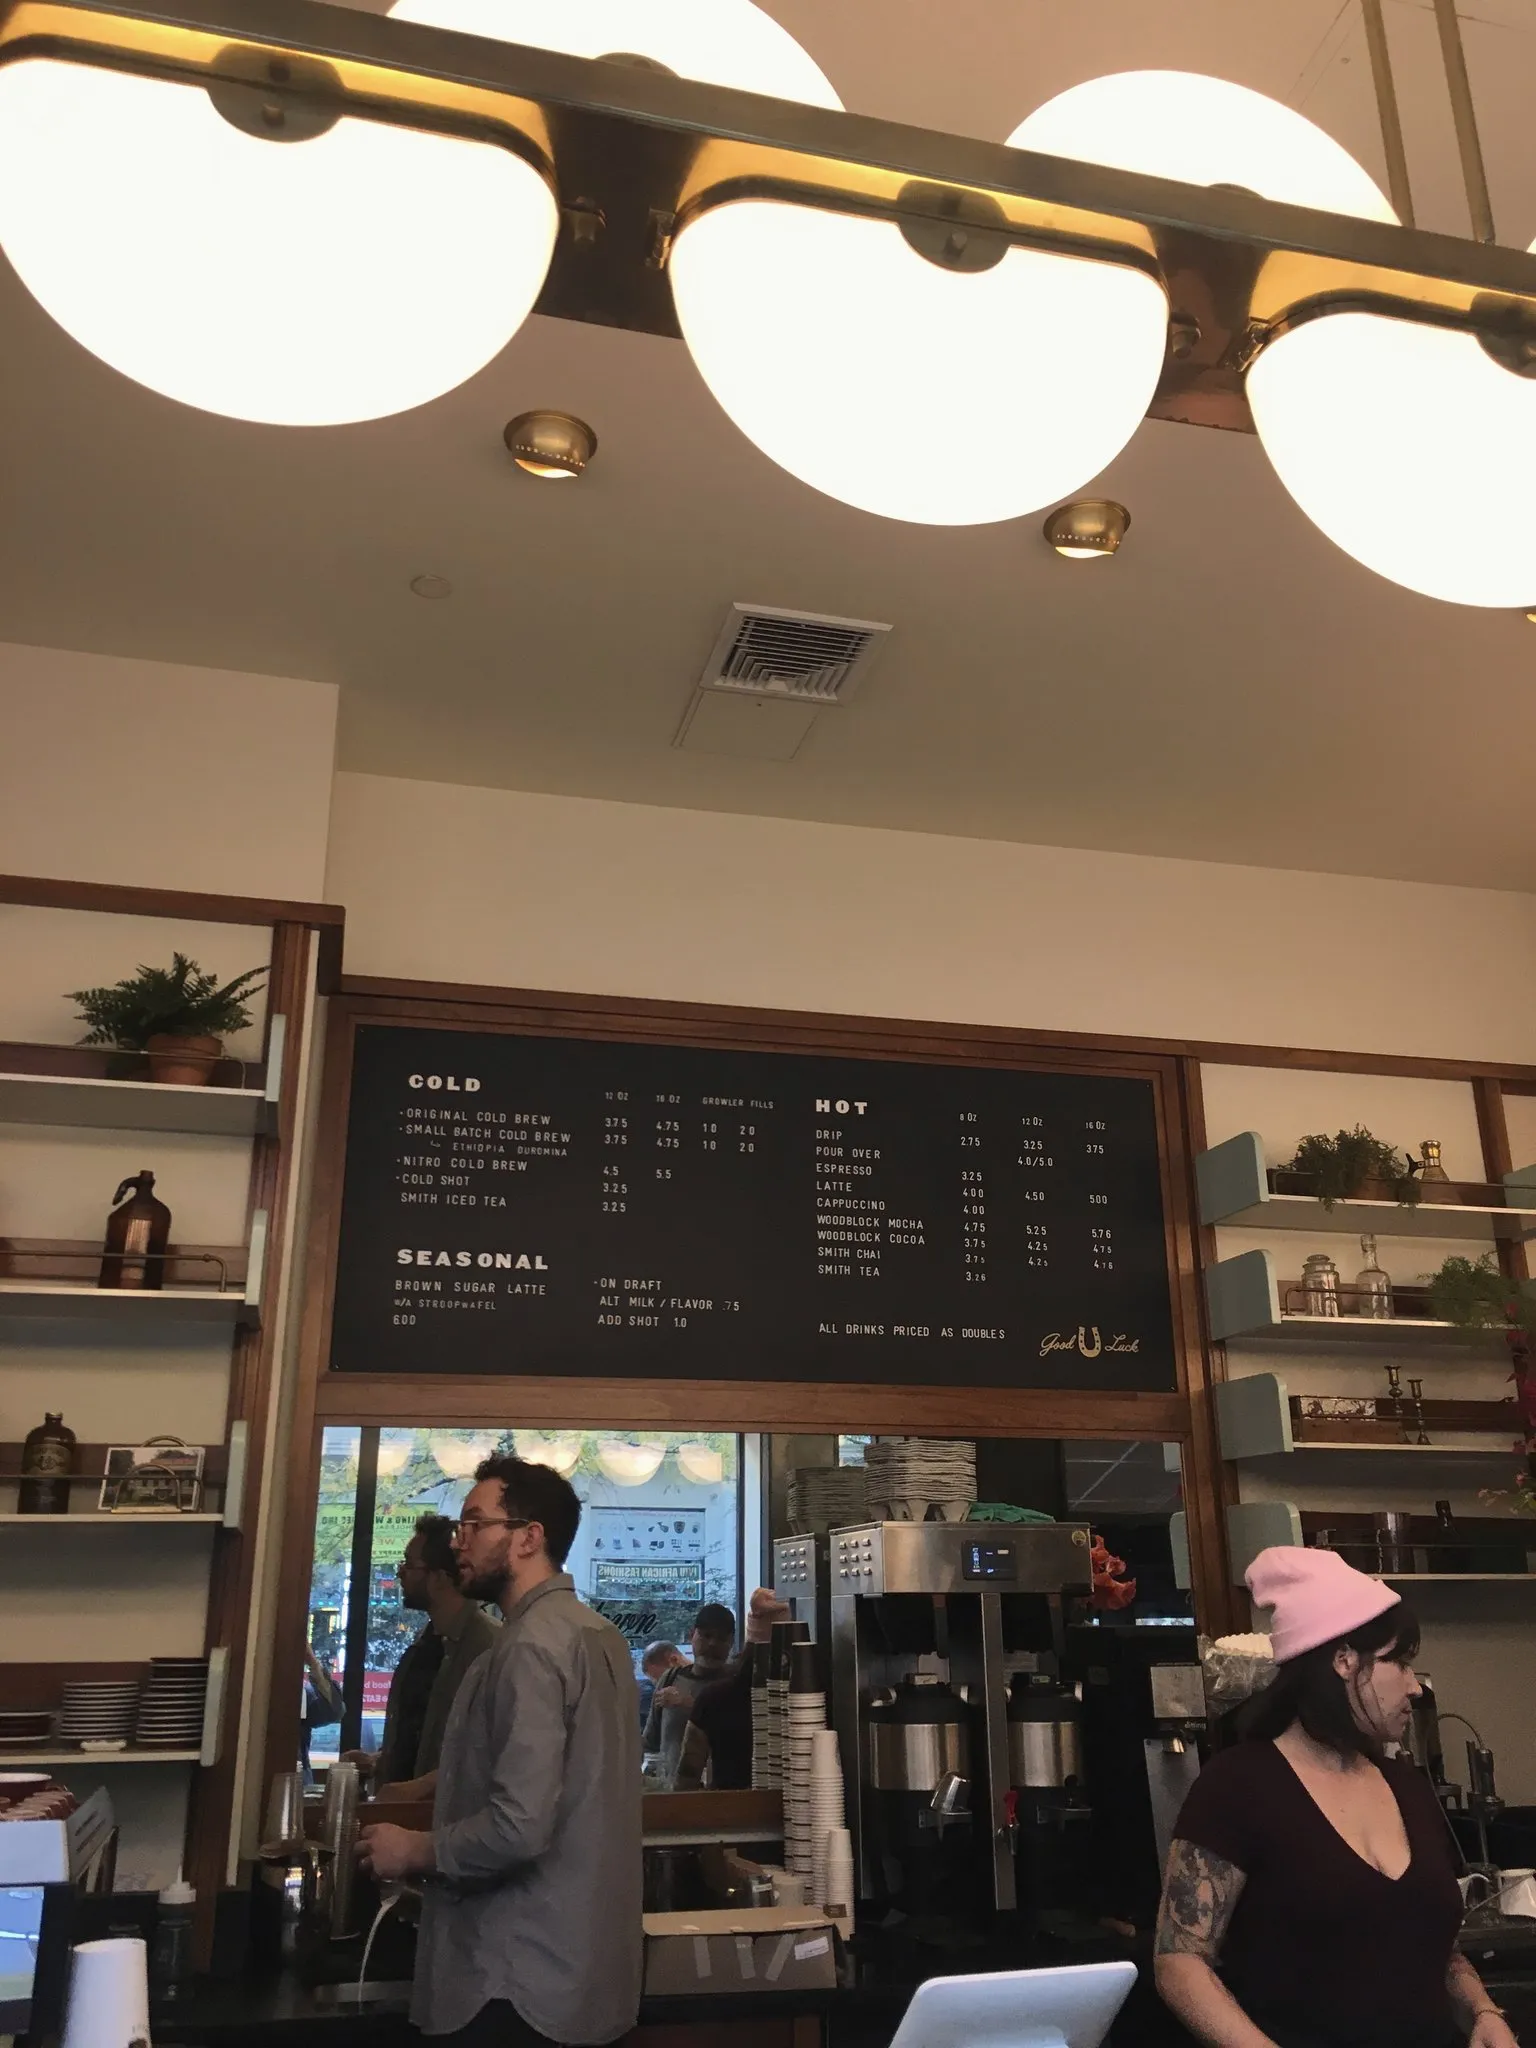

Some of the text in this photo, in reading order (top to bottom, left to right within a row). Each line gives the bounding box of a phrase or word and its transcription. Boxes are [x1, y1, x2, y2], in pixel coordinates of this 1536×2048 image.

[409, 1075, 480, 1091] COLD
[617, 1092, 628, 1100] OZ
[669, 1095, 680, 1103] OZ
[703, 1097, 773, 1109] GROWLER FILLS
[816, 1099, 867, 1114] HOT
[477, 1112, 506, 1123] COLD
[515, 1114, 550, 1124] BREW
[656, 1121, 679, 1131] 4.75
[704, 1124, 716, 1133] 10
[740, 1126, 754, 1135] 20
[454, 1127, 491, 1138] BATCH
[499, 1130, 527, 1140] COLD
[535, 1132, 570, 1142] BREW
[605, 1134, 627, 1144] 3.75
[816, 1130, 842, 1140] DRIP
[657, 1138, 679, 1148] 4.75
[703, 1141, 716, 1150] 10
[961, 1137, 980, 1146] 2.75
[453, 1143, 504, 1152] ETHIOPIA
[740, 1143, 754, 1152] 20
[816, 1146, 880, 1158] POUR OVER
[404, 1156, 527, 1170] NITRO COLD BREW
[604, 1166, 618, 1175] 4.5
[657, 1169, 671, 1179] 5.5
[817, 1163, 871, 1175] ESPRESSO
[403, 1174, 469, 1185] COLD SHOT
[962, 1172, 982, 1181] 3.25
[604, 1183, 627, 1193] 3.25
[817, 1181, 852, 1191] LATTE
[401, 1193, 506, 1206] SMITH ICED TEA
[1025, 1192, 1044, 1200] 4.50
[603, 1202, 625, 1212] 3.25
[817, 1198, 885, 1210] CAPPUCCINO
[817, 1215, 923, 1229] WOODBLOCK MOCHA
[964, 1222, 985, 1232] 4.75
[1027, 1225, 1046, 1235] 5.25
[817, 1231, 924, 1244] WOODBLOCK COCOA
[965, 1238, 985, 1248] 3.75
[818, 1247, 880, 1259] SMITH CHAI
[398, 1249, 548, 1269] SEASONAL
[818, 1265, 879, 1276] SMITH TEA
[396, 1280, 545, 1295] BROWN SUGAR LATTE
[625, 1280, 661, 1290] DRAFT
[600, 1296, 619, 1306] ALT
[629, 1297, 654, 1307] MILK
[671, 1299, 712, 1309] FLAVOR
[598, 1315, 621, 1325] ADD
[629, 1316, 659, 1326] SHOT
[819, 1323, 1004, 1339] ALL DRINKS PRICED AS DOUBLES
[1040, 1333, 1139, 1356] Good Luck
